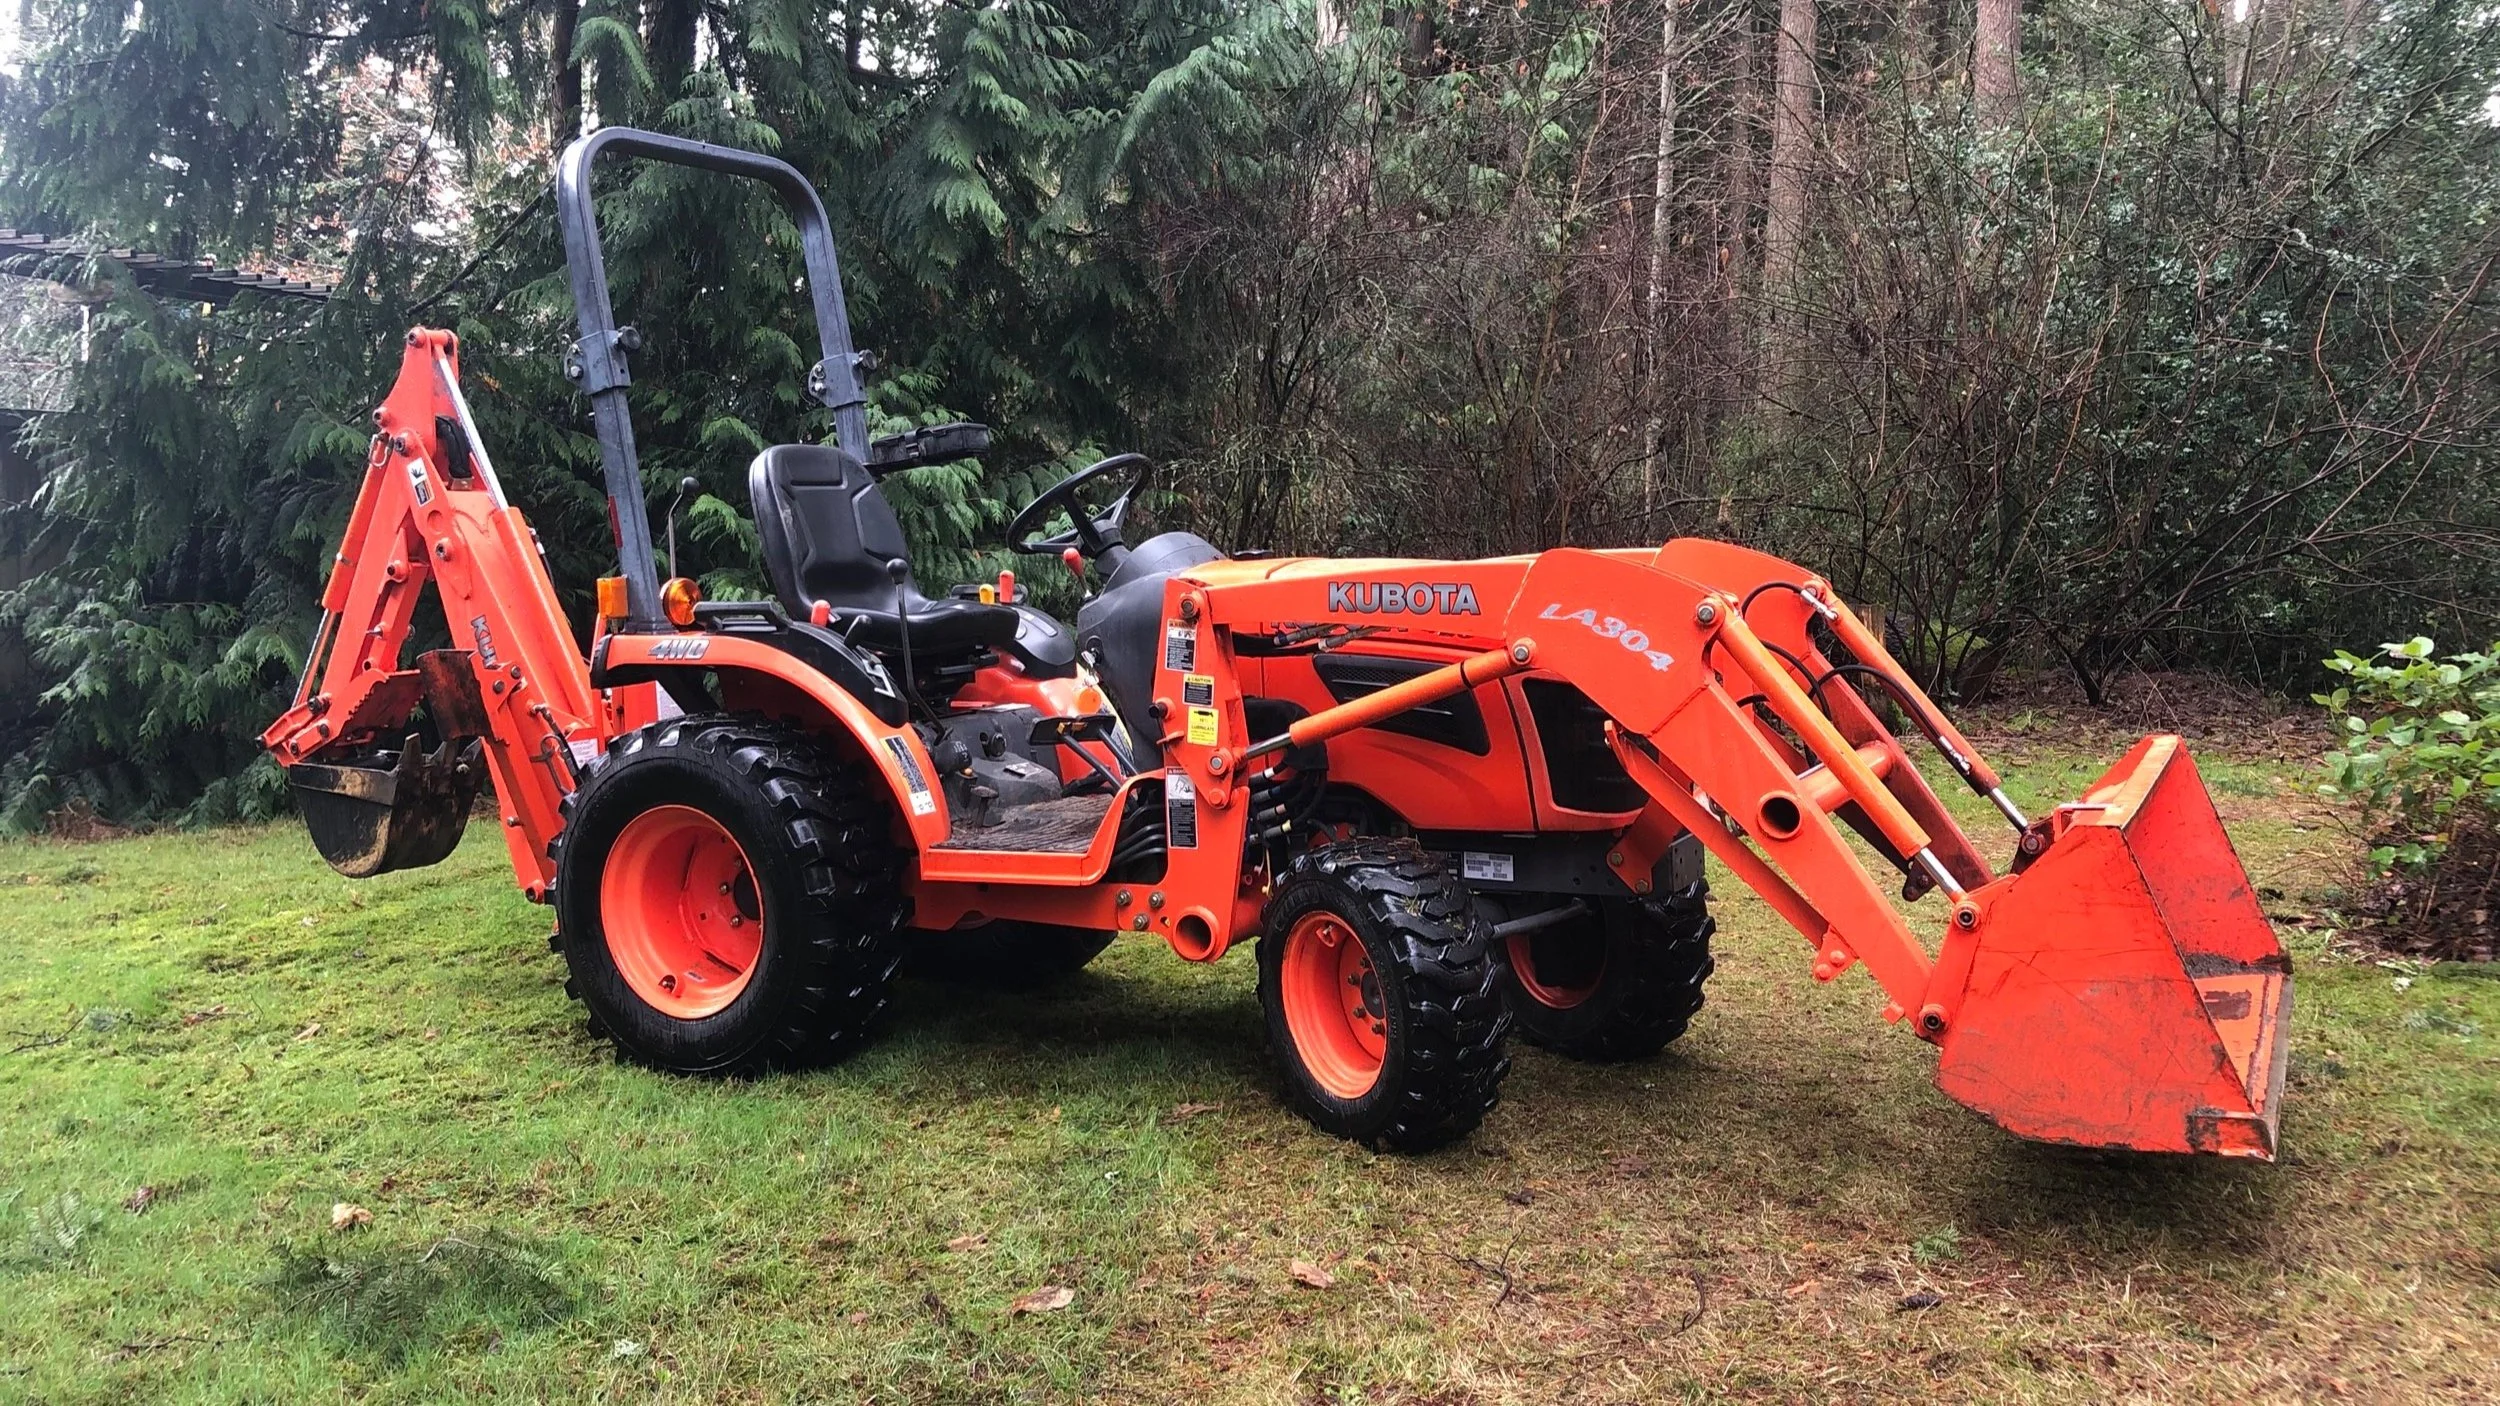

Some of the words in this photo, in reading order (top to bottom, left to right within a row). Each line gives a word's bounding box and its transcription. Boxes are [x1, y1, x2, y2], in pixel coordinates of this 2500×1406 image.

[1328, 581, 1481, 615] KUBOTA
[648, 639, 710, 660] 4WD
[1538, 603, 1675, 671] LA304
